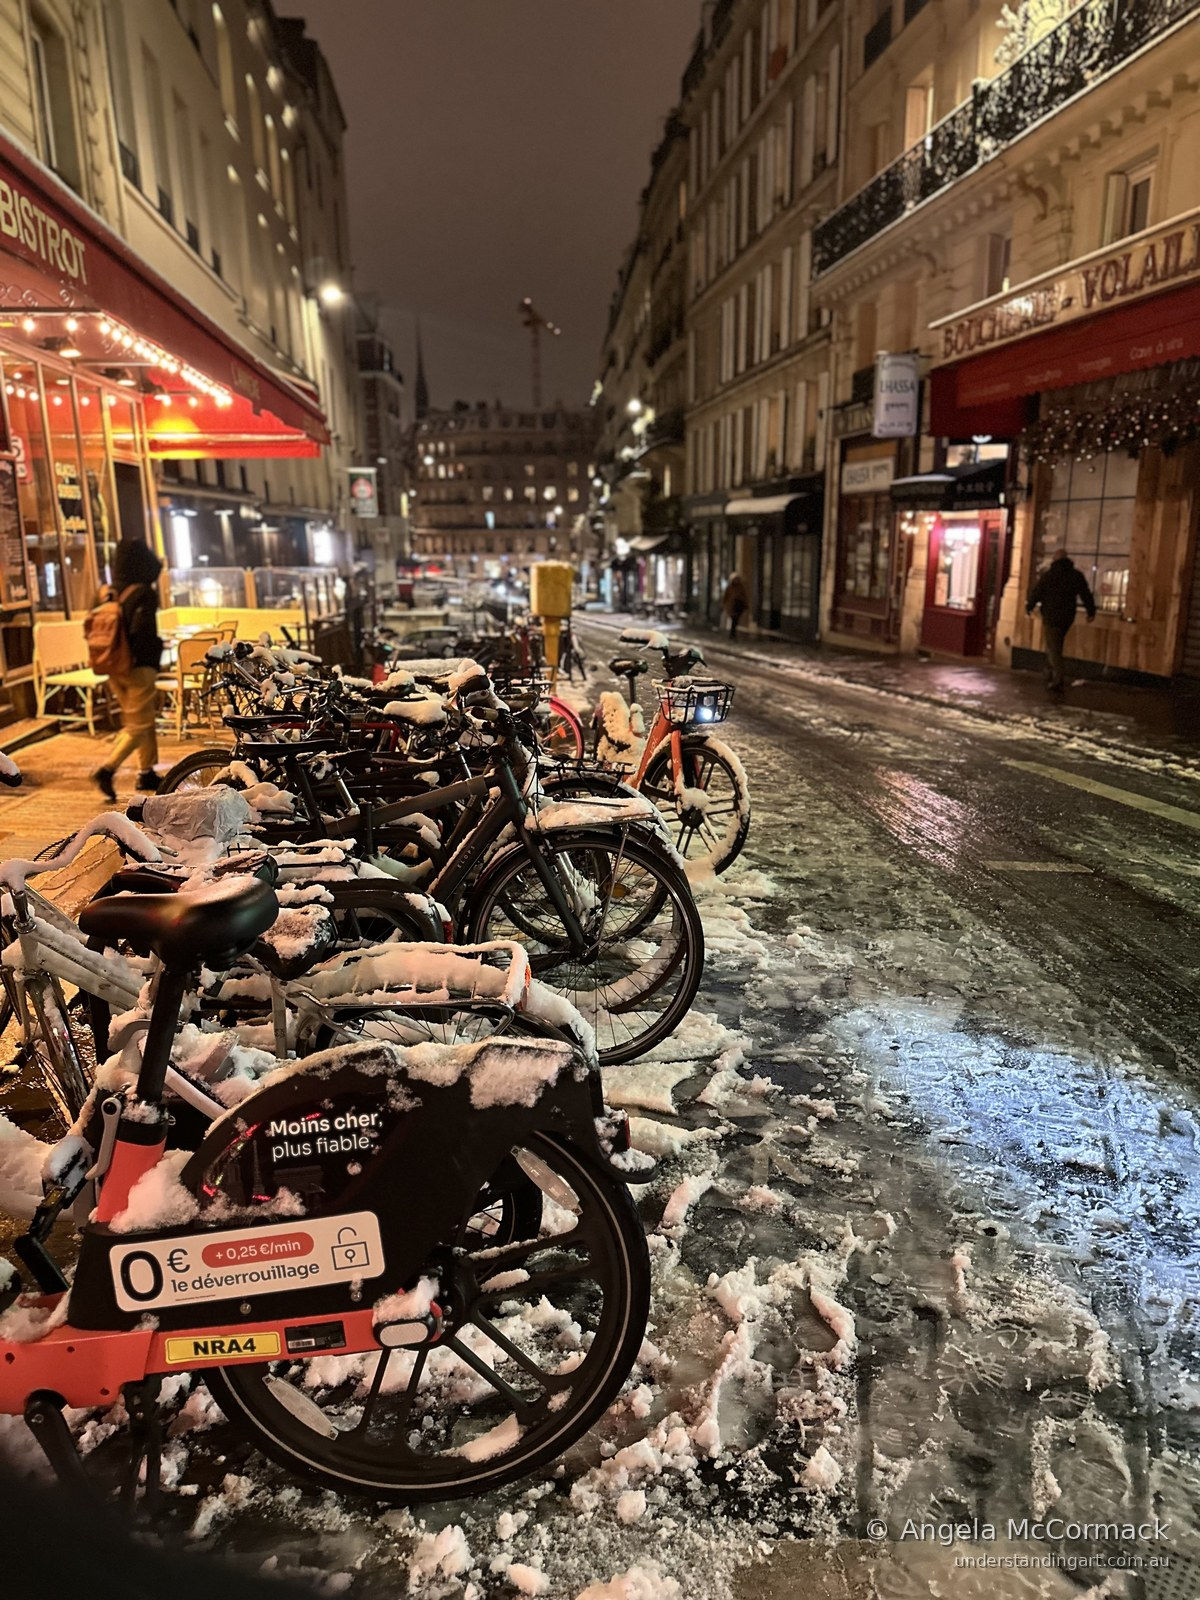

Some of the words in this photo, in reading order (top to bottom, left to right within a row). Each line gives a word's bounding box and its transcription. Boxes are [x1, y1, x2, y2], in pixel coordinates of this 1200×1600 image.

[0, 179, 87, 285] BISTROT
[270, 1117, 330, 1137] Moins
[334, 1112, 383, 1130] cher,
[272, 1141, 312, 1162] plus
[316, 1134, 374, 1154] fiable.
[226, 1245, 258, 1262] 0,25
[260, 1240, 301, 1257] €/min
[120, 1250, 164, 1302] 0
[167, 1248, 191, 1274] €
[171, 1279, 188, 1293] le
[191, 1262, 320, 1291] déverrouillage
[193, 1337, 257, 1356] NRA4
